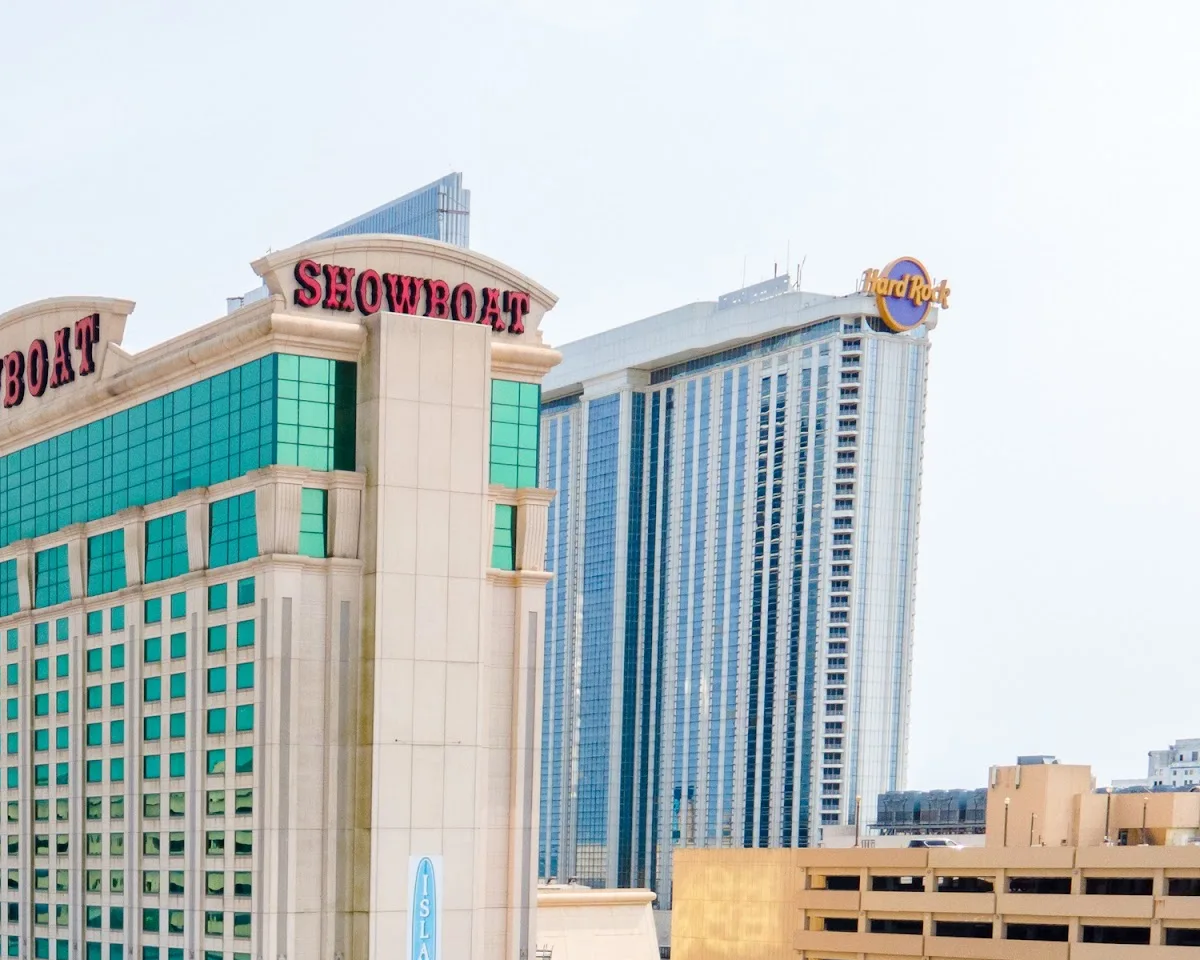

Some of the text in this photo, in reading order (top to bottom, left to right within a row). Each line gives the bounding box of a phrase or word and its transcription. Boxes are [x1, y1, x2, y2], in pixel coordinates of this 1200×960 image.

[293, 259, 531, 335] SHOWBOAT
[863, 268, 951, 309] Hard Rock
